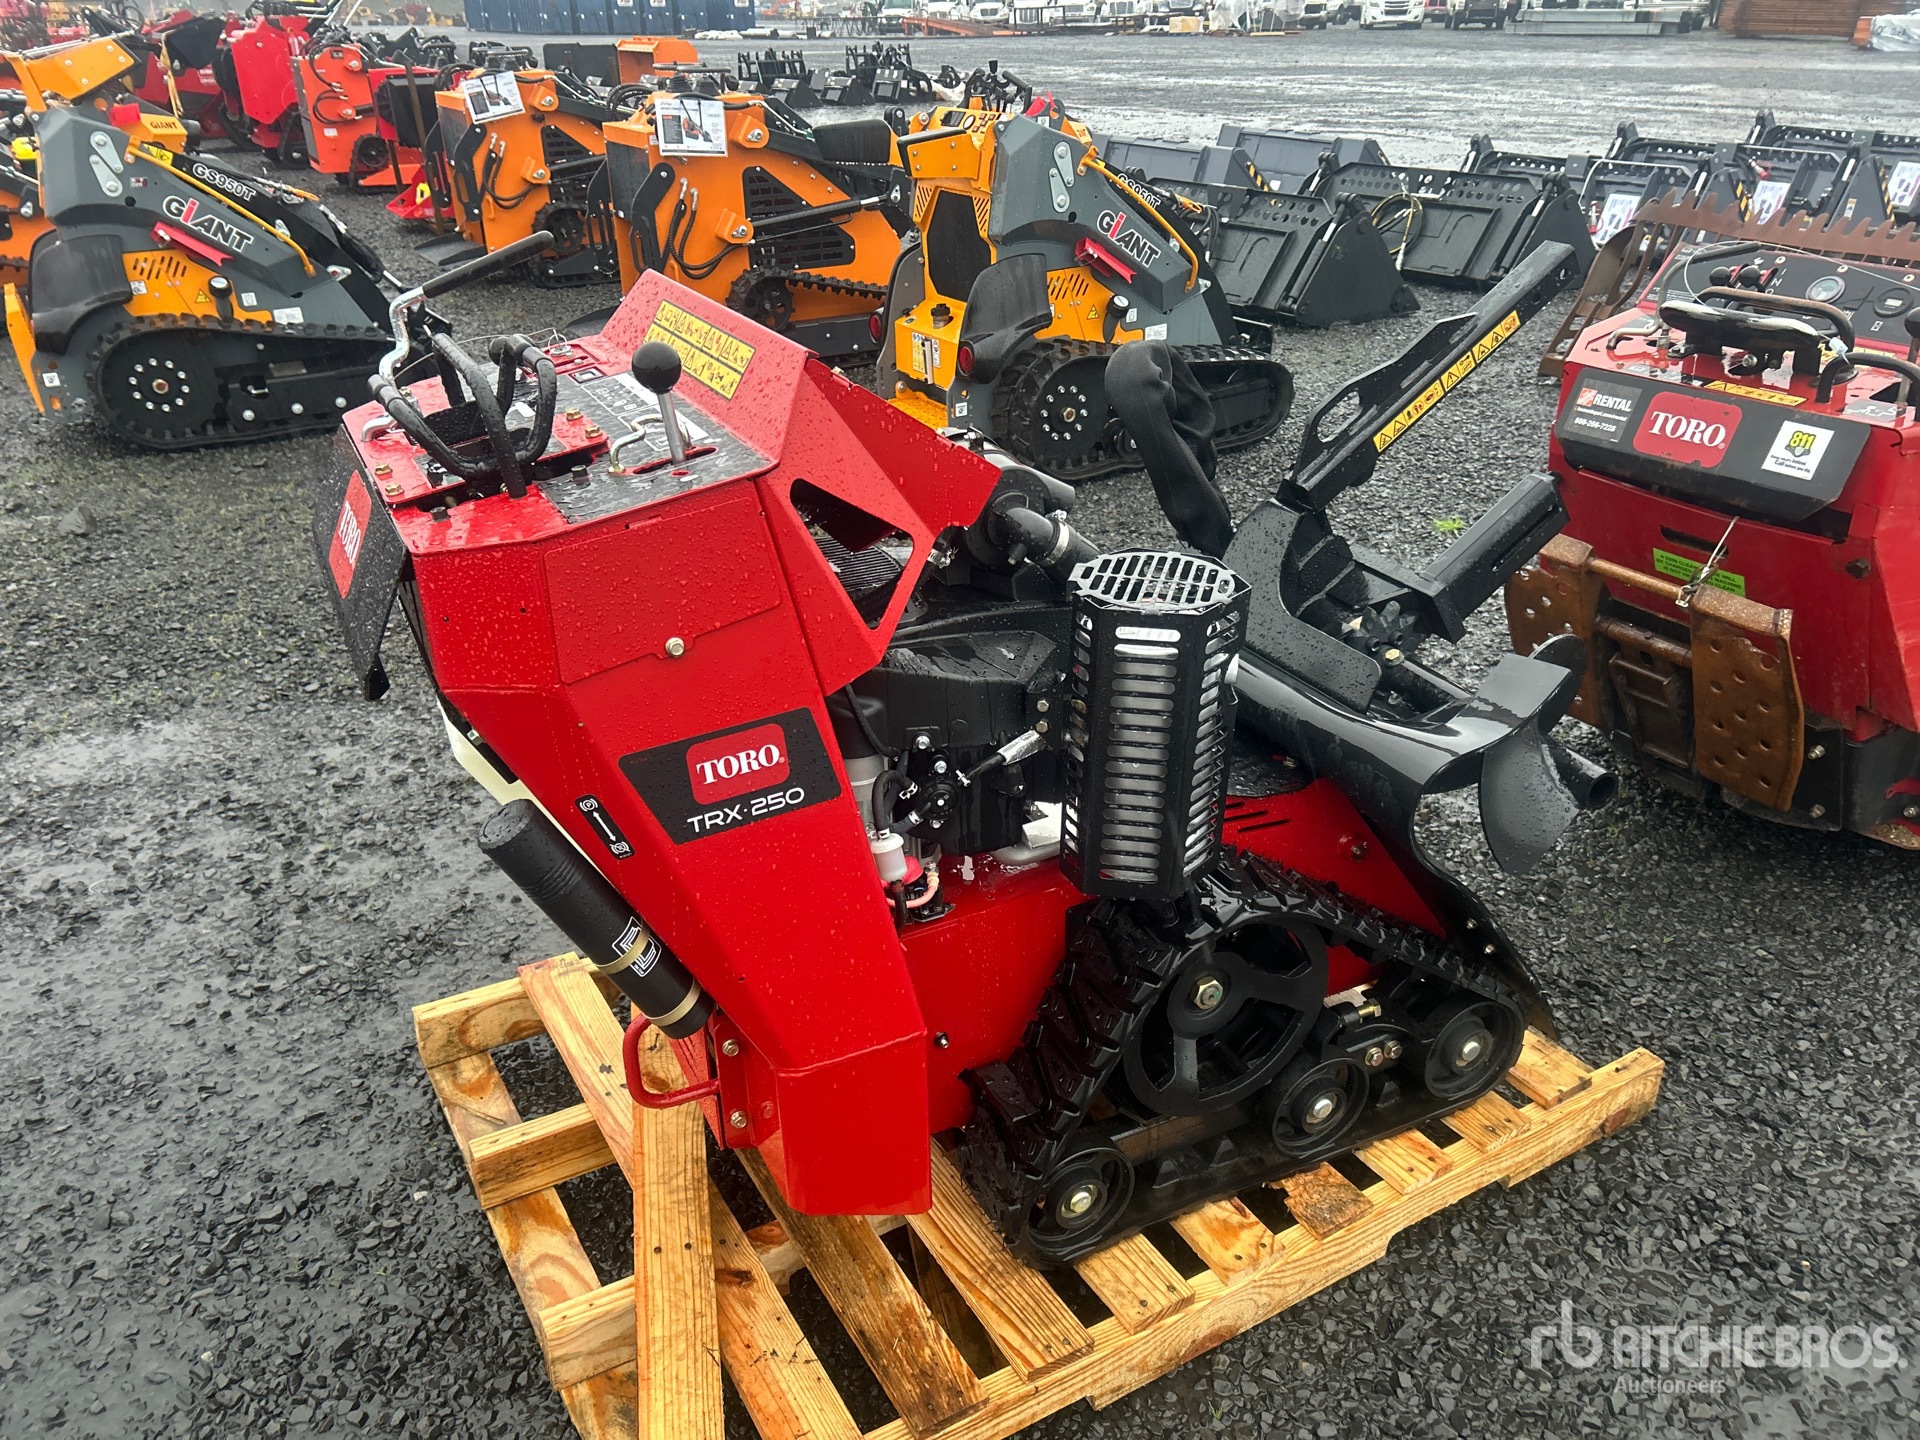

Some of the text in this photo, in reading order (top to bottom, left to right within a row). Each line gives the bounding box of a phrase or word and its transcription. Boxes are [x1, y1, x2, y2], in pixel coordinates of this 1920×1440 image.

[150, 121, 178, 129] GIANT
[192, 163, 256, 201] GS950T
[1593, 393, 1632, 412] RENTAL
[1648, 411, 1726, 447] TORO
[1789, 430, 1816, 449] 811
[338, 500, 361, 564] TORO
[696, 744, 780, 785] TORO
